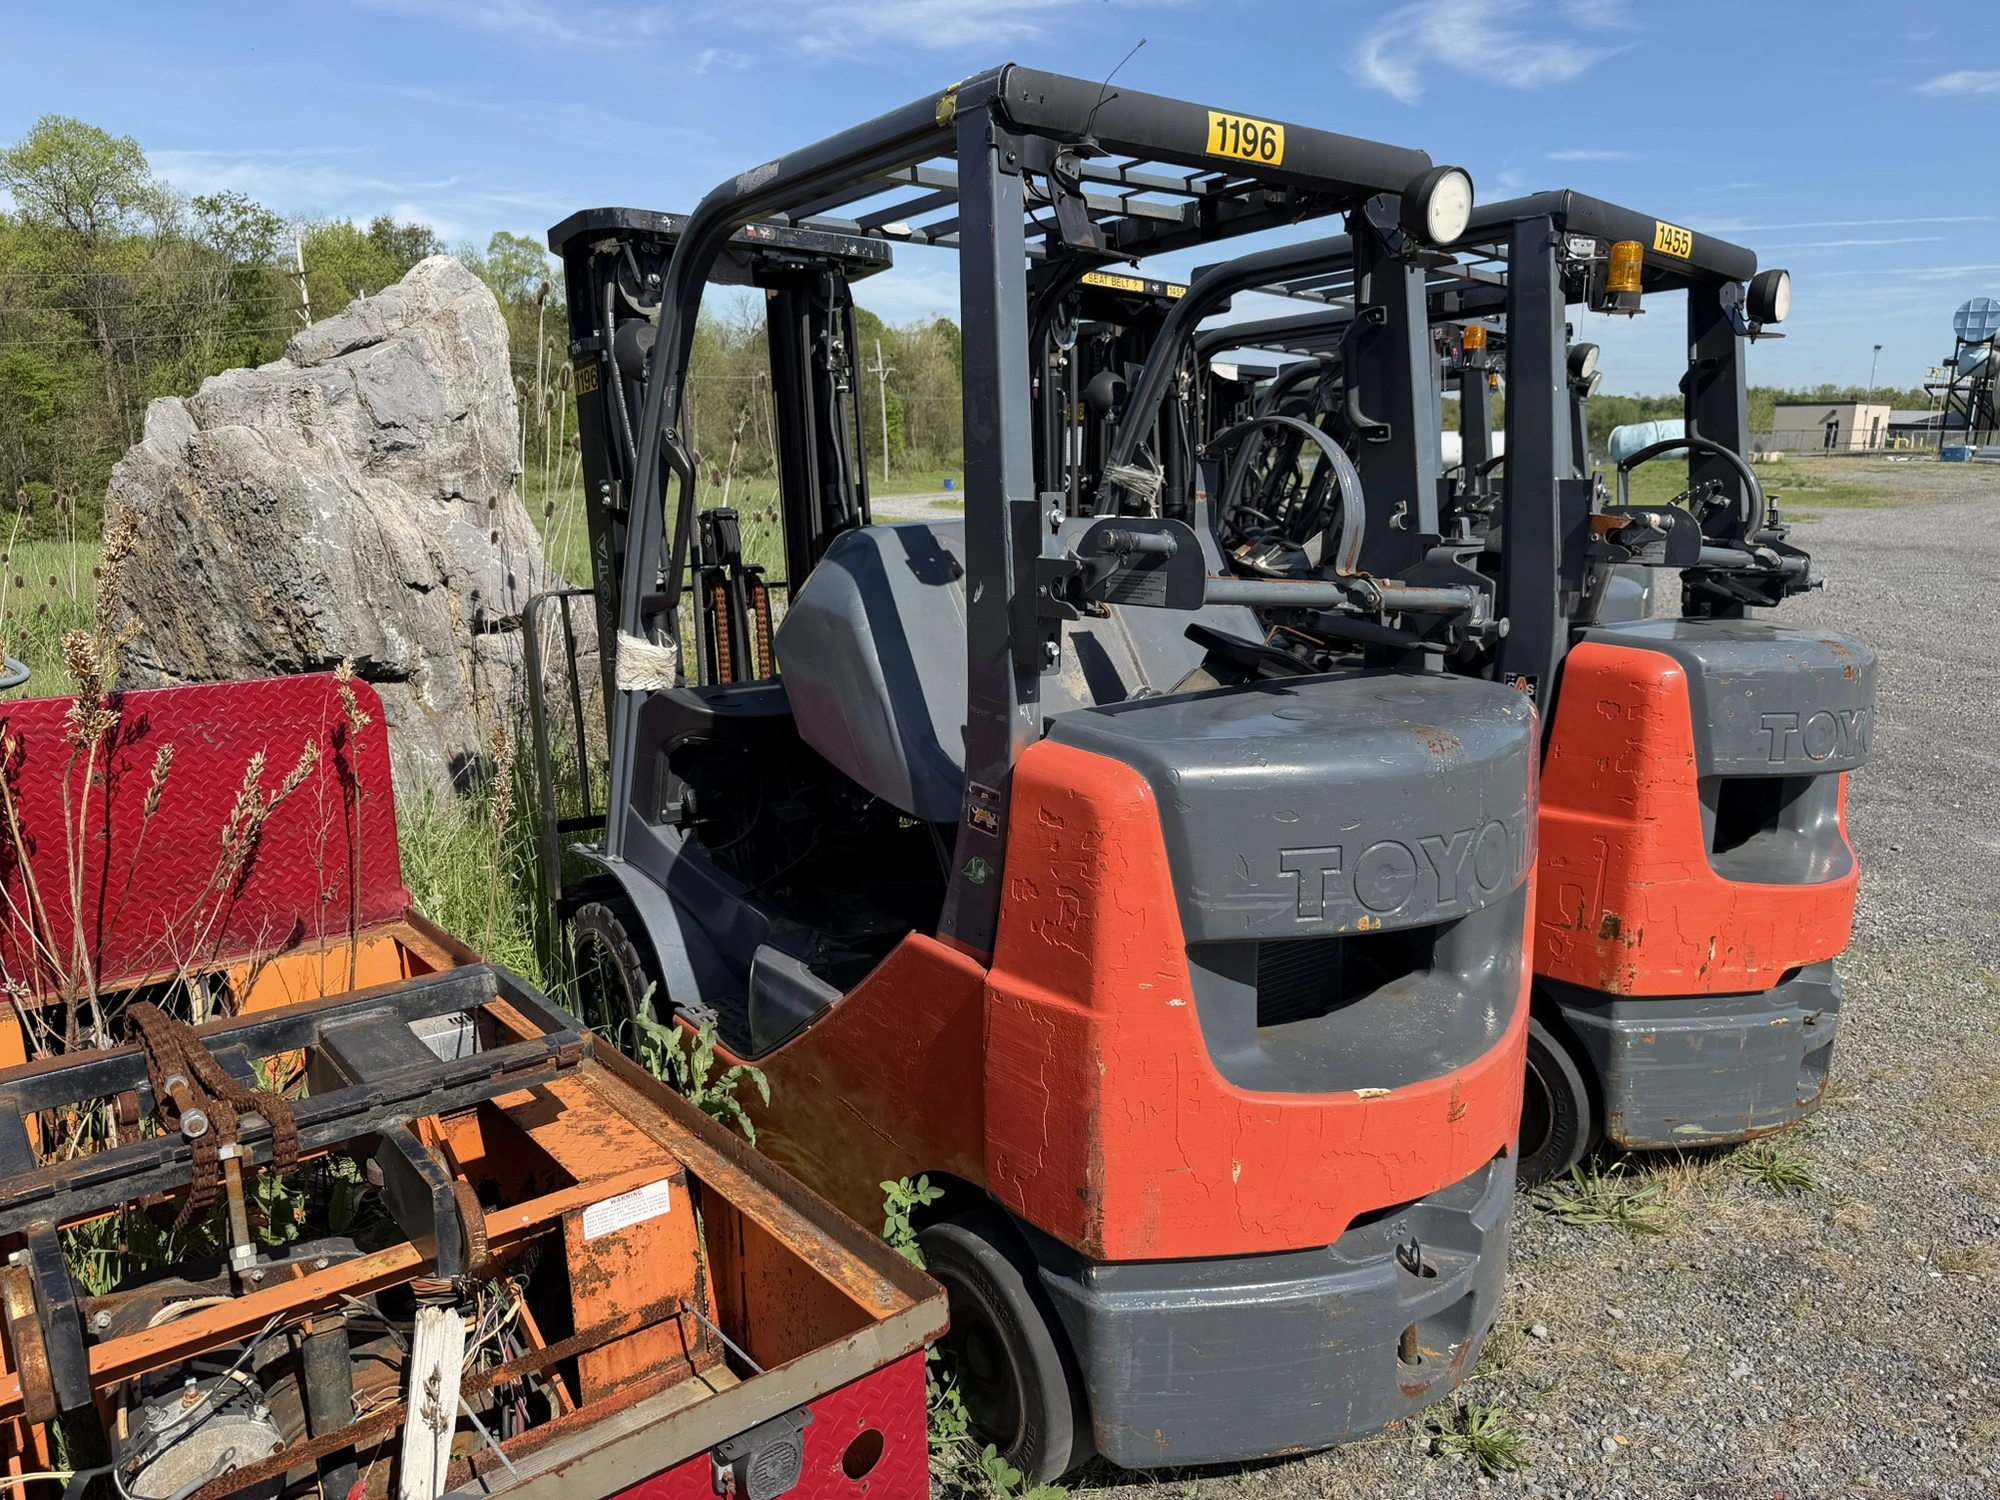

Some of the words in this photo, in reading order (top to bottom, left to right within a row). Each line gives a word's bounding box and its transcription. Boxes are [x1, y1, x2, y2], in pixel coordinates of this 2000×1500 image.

[1216, 117, 1277, 161] 1196
[1660, 225, 1689, 255] 1455
[1088, 273, 1109, 285] SEAT
[1111, 277, 1130, 288] BELT
[1168, 286, 1184, 297] 1455
[575, 366, 598, 394] 1196
[596, 533, 617, 672] TOYOTA
[610, 1189, 643, 1205] WARNING
